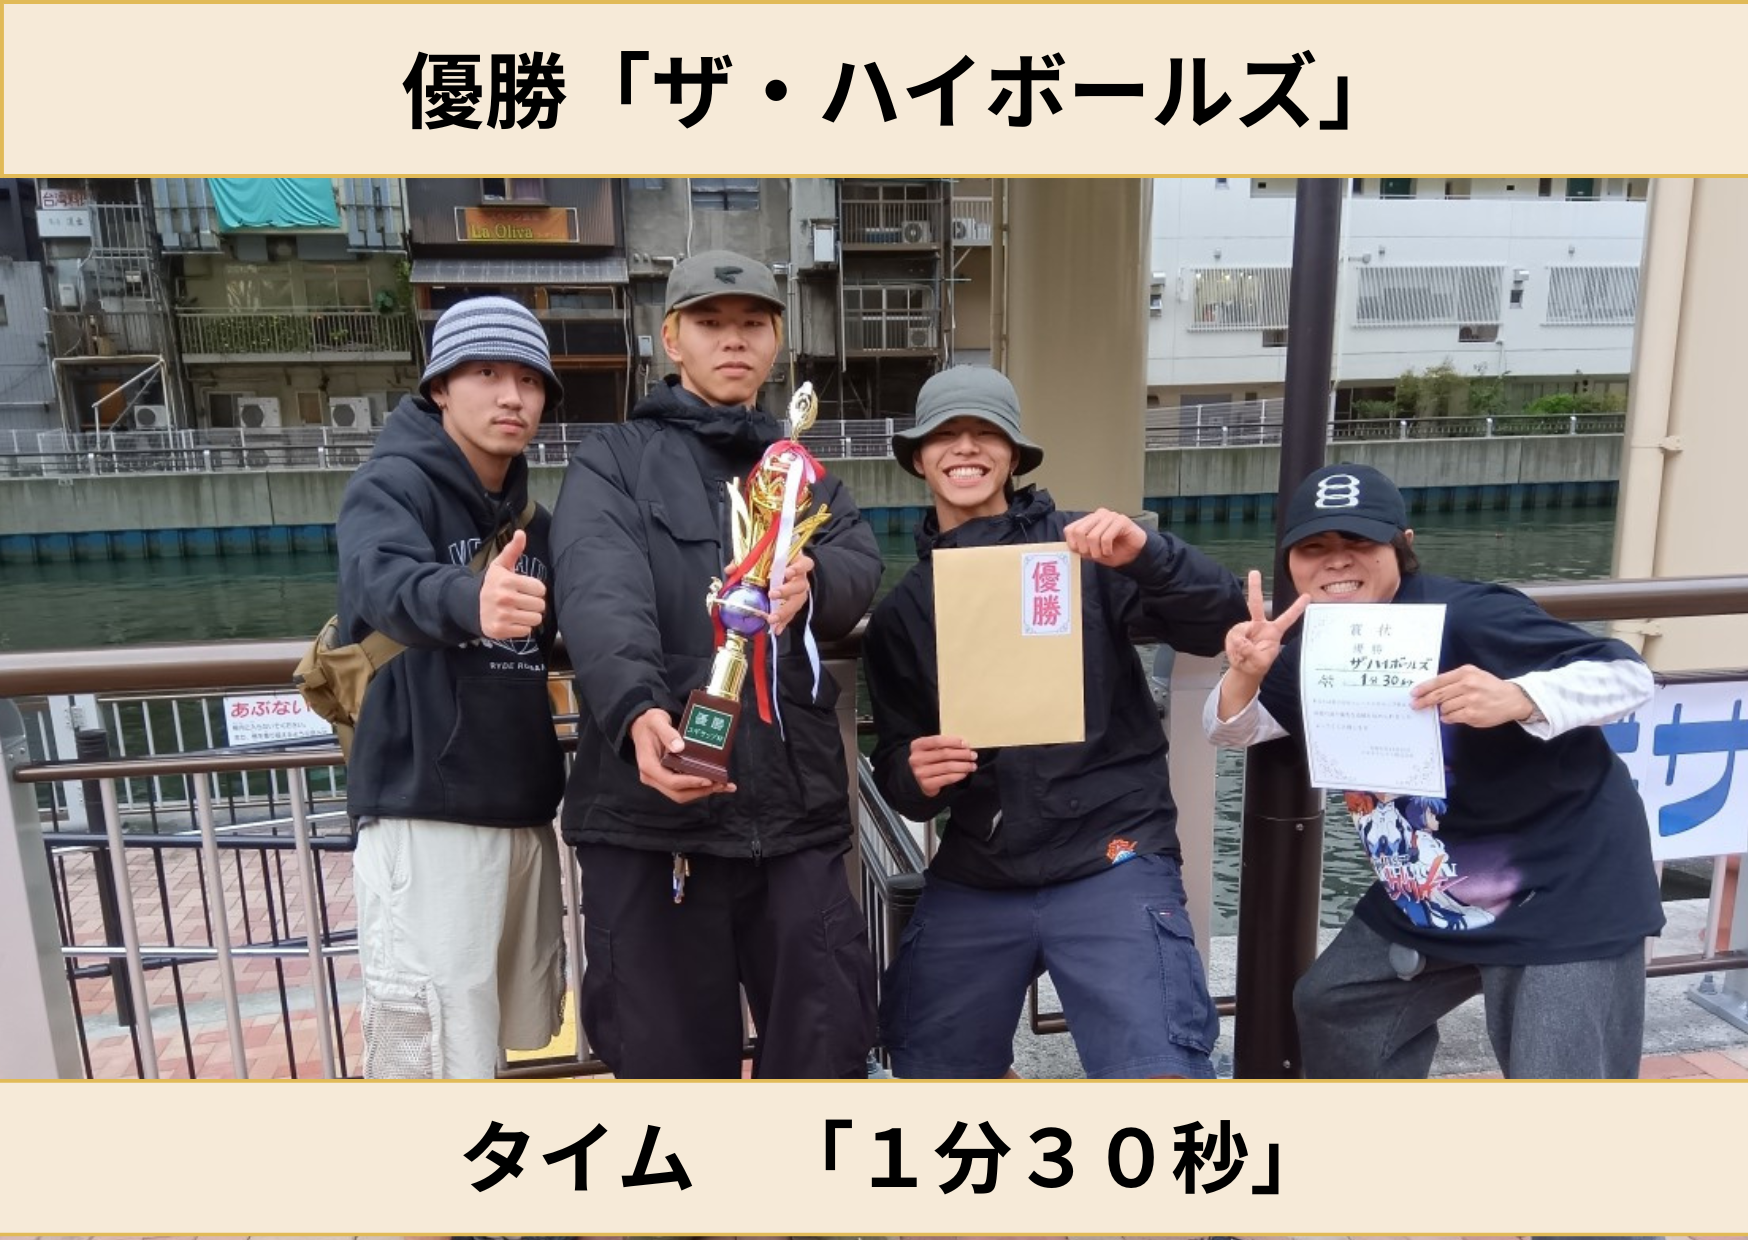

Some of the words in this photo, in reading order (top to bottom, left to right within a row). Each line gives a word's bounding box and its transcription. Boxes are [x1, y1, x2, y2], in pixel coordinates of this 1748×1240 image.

[470, 224, 490, 239] La
[495, 224, 533, 239] Oliva
[1031, 560, 1062, 626] 優勝
